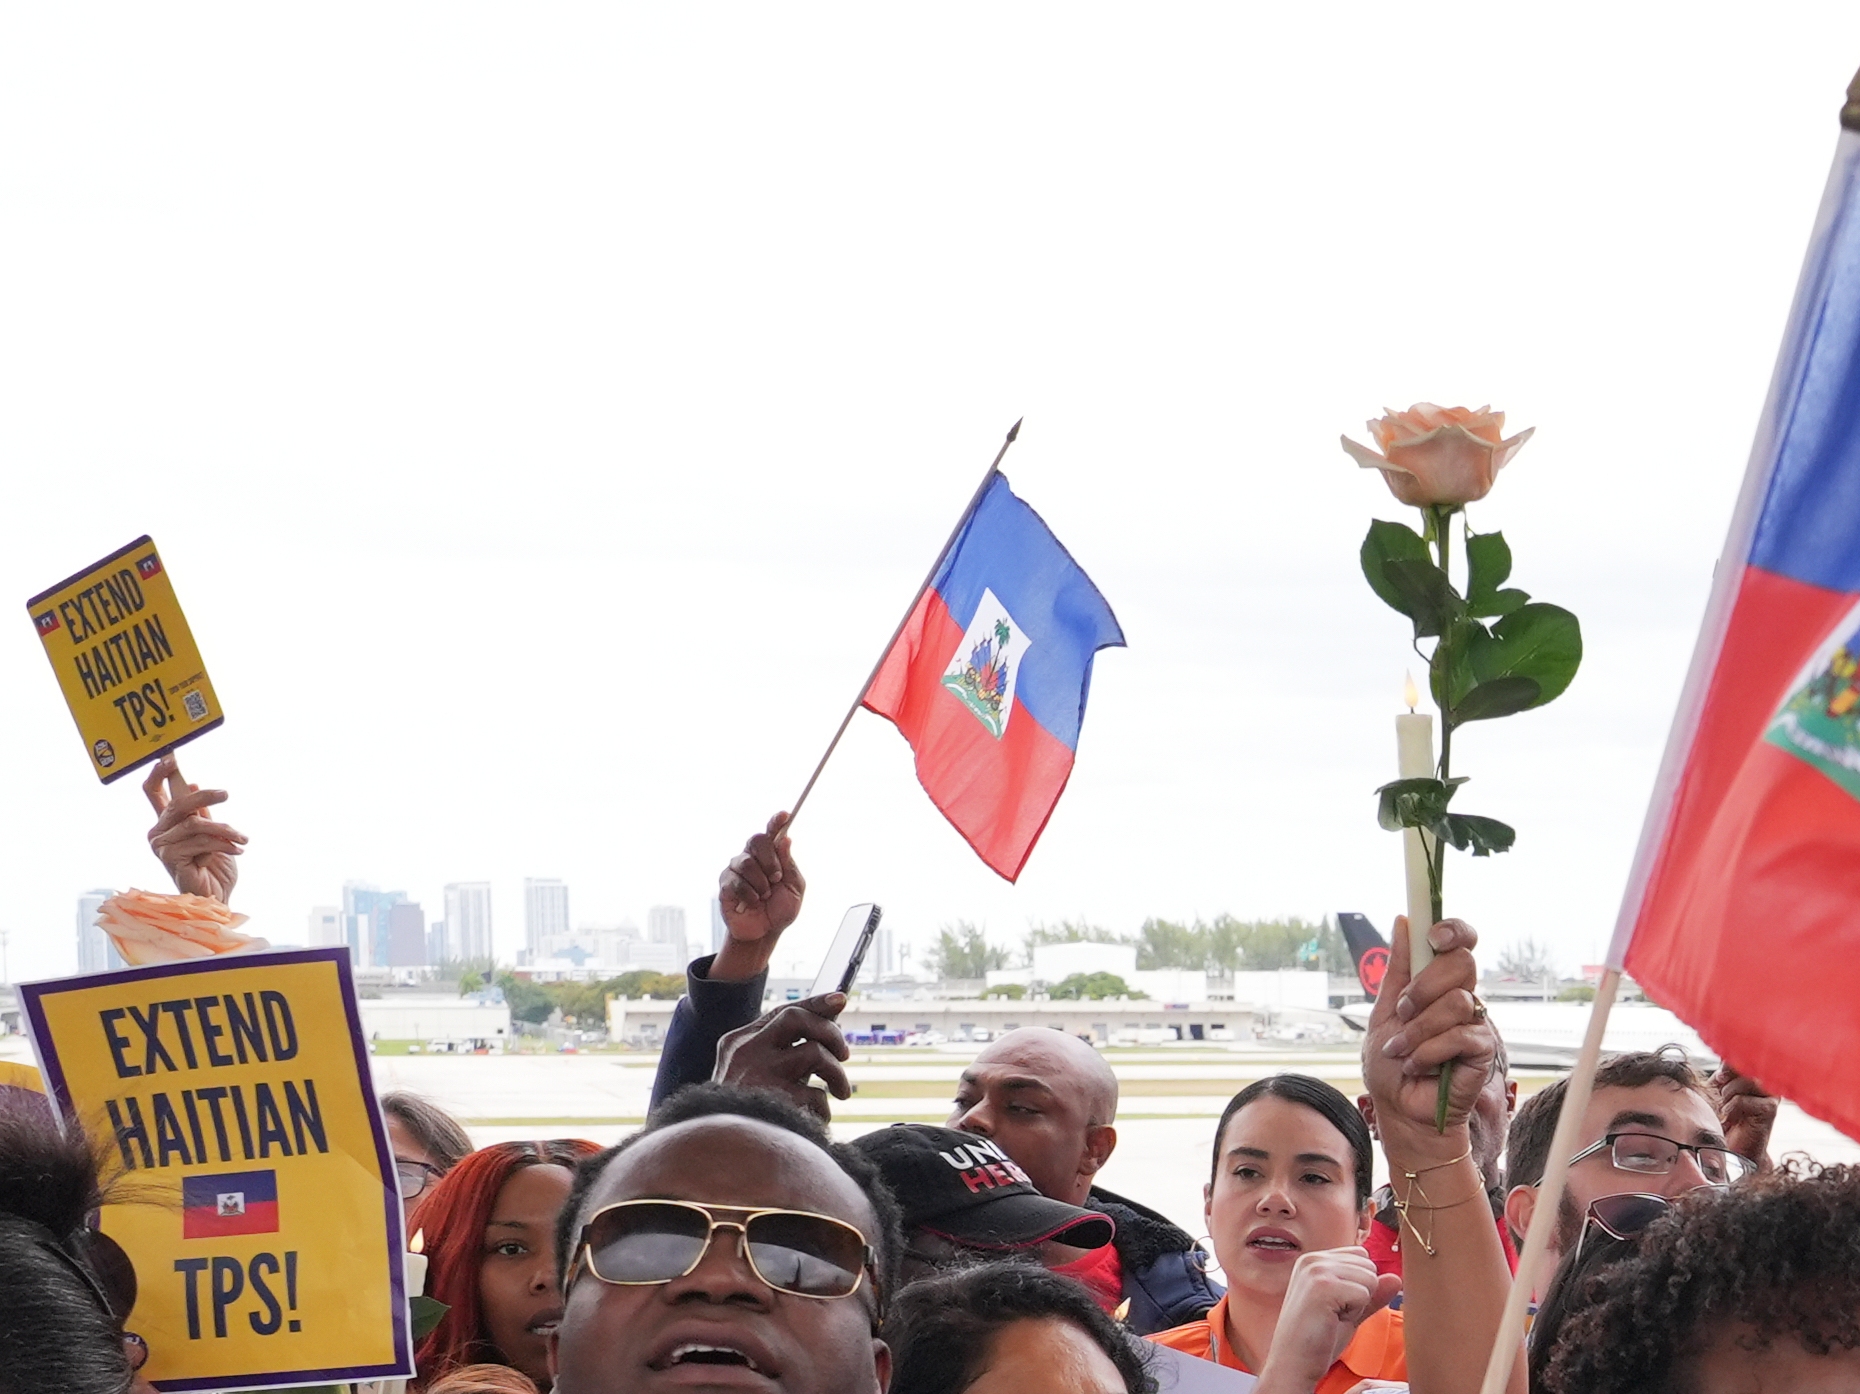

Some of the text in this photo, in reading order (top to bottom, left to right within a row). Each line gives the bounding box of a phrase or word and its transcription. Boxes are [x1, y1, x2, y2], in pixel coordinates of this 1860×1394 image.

[59, 568, 146, 645] EXTEND
[74, 613, 174, 700] HAITIAN
[113, 678, 176, 742] TPS!
[99, 990, 299, 1079] EXTEND
[105, 1079, 329, 1170] HAITIAN
[939, 1139, 1009, 1170] UNI
[960, 1160, 1033, 1194] HER
[174, 1250, 302, 1340] TPS!
